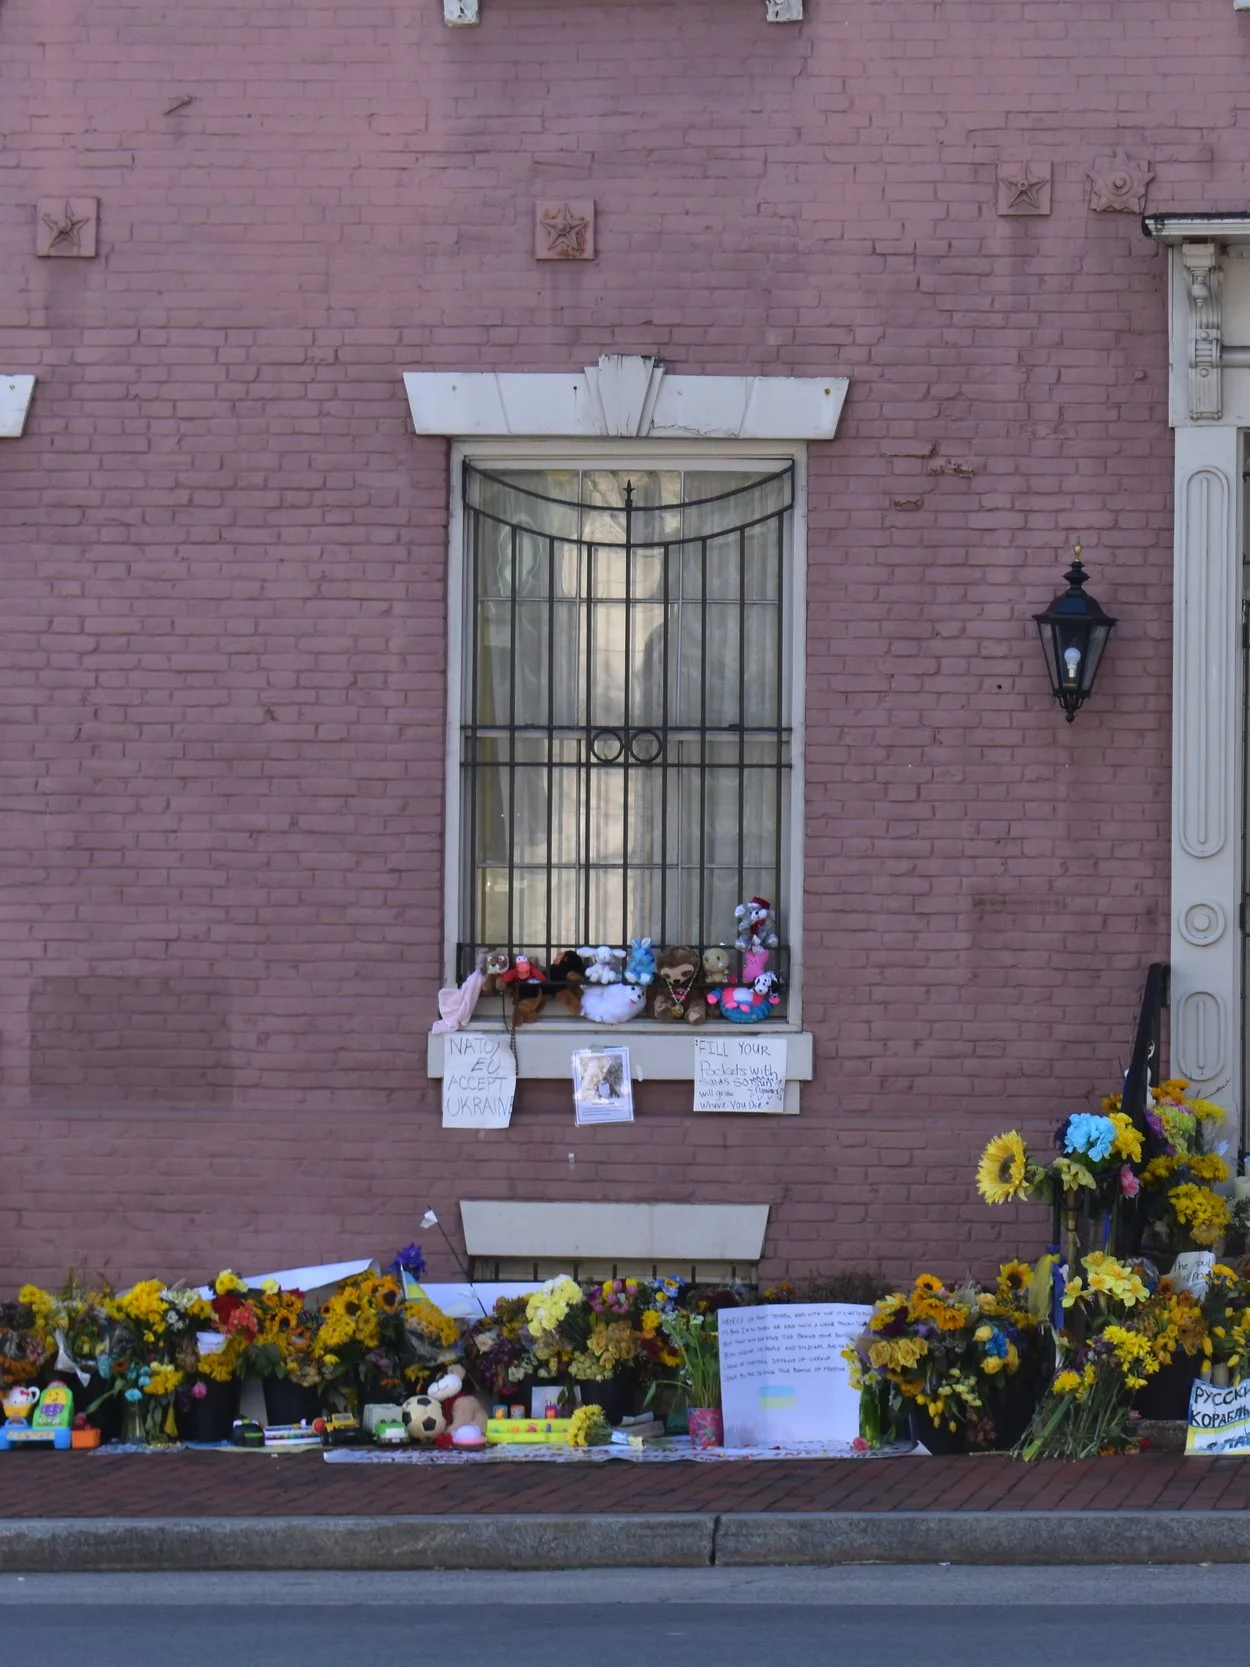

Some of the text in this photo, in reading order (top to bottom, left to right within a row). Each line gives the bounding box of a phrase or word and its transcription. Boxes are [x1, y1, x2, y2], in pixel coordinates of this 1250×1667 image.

[738, 1041, 771, 1057] YOUR
[448, 1075, 508, 1092] ACCEPT
[699, 1089, 714, 1098] will
[715, 1090, 734, 1101] grow
[1190, 1404, 1250, 1428] КОРАБЛЬ
